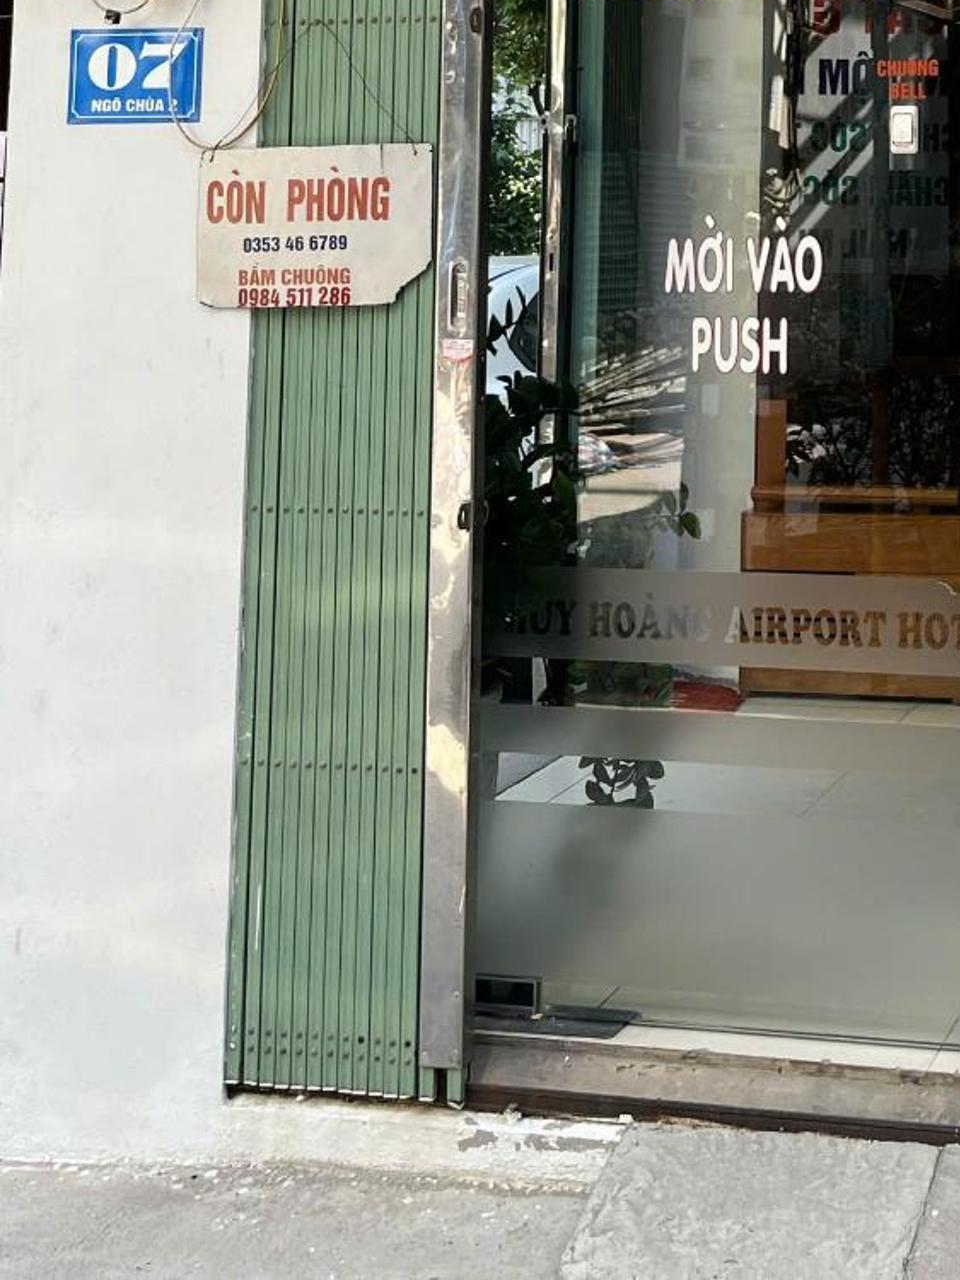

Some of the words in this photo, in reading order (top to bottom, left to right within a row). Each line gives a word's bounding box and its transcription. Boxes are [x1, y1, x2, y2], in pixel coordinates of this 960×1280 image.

[88, 42, 187, 92] 07
[126, 95, 164, 113] CHÙA
[891, 82, 926, 100] BELL
[206, 169, 266, 225] CÒN
[286, 166, 391, 222] PHÒNG
[243, 237, 280, 253] 0353
[285, 236, 304, 251] 46
[309, 234, 347, 250] 6789
[664, 215, 734, 293] MỜI
[747, 216, 823, 294] VÀO
[239, 288, 279, 307] 0984
[286, 287, 313, 306] 511
[318, 286, 351, 305] 286
[692, 317, 788, 375] PUSH
[724, 605, 888, 649] AIRPORT
